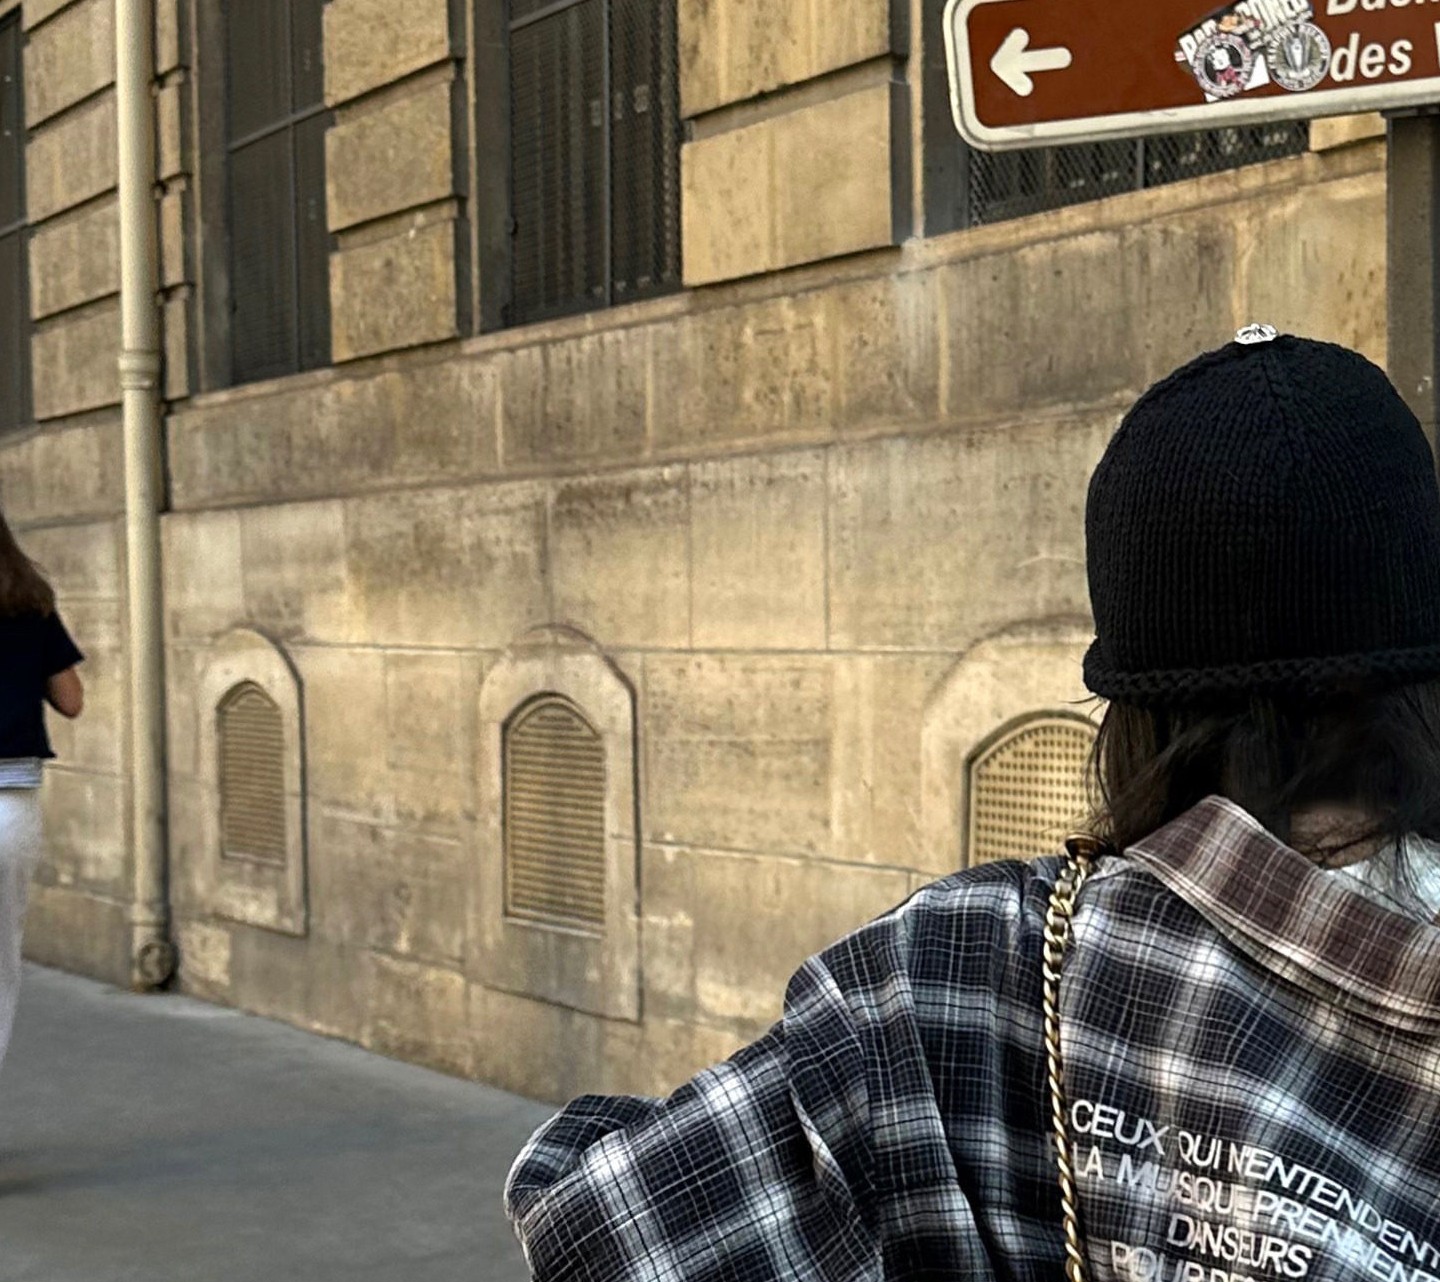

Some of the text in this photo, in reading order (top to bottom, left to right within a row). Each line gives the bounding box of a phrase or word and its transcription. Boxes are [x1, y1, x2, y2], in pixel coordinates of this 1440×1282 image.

[1329, 32, 1413, 82] des
[1071, 1100, 1169, 1156] CEUX
[1178, 1130, 1222, 1170] QUI
[1072, 1141, 1105, 1181] LA
[1166, 1213, 1313, 1279] DANSEURS
